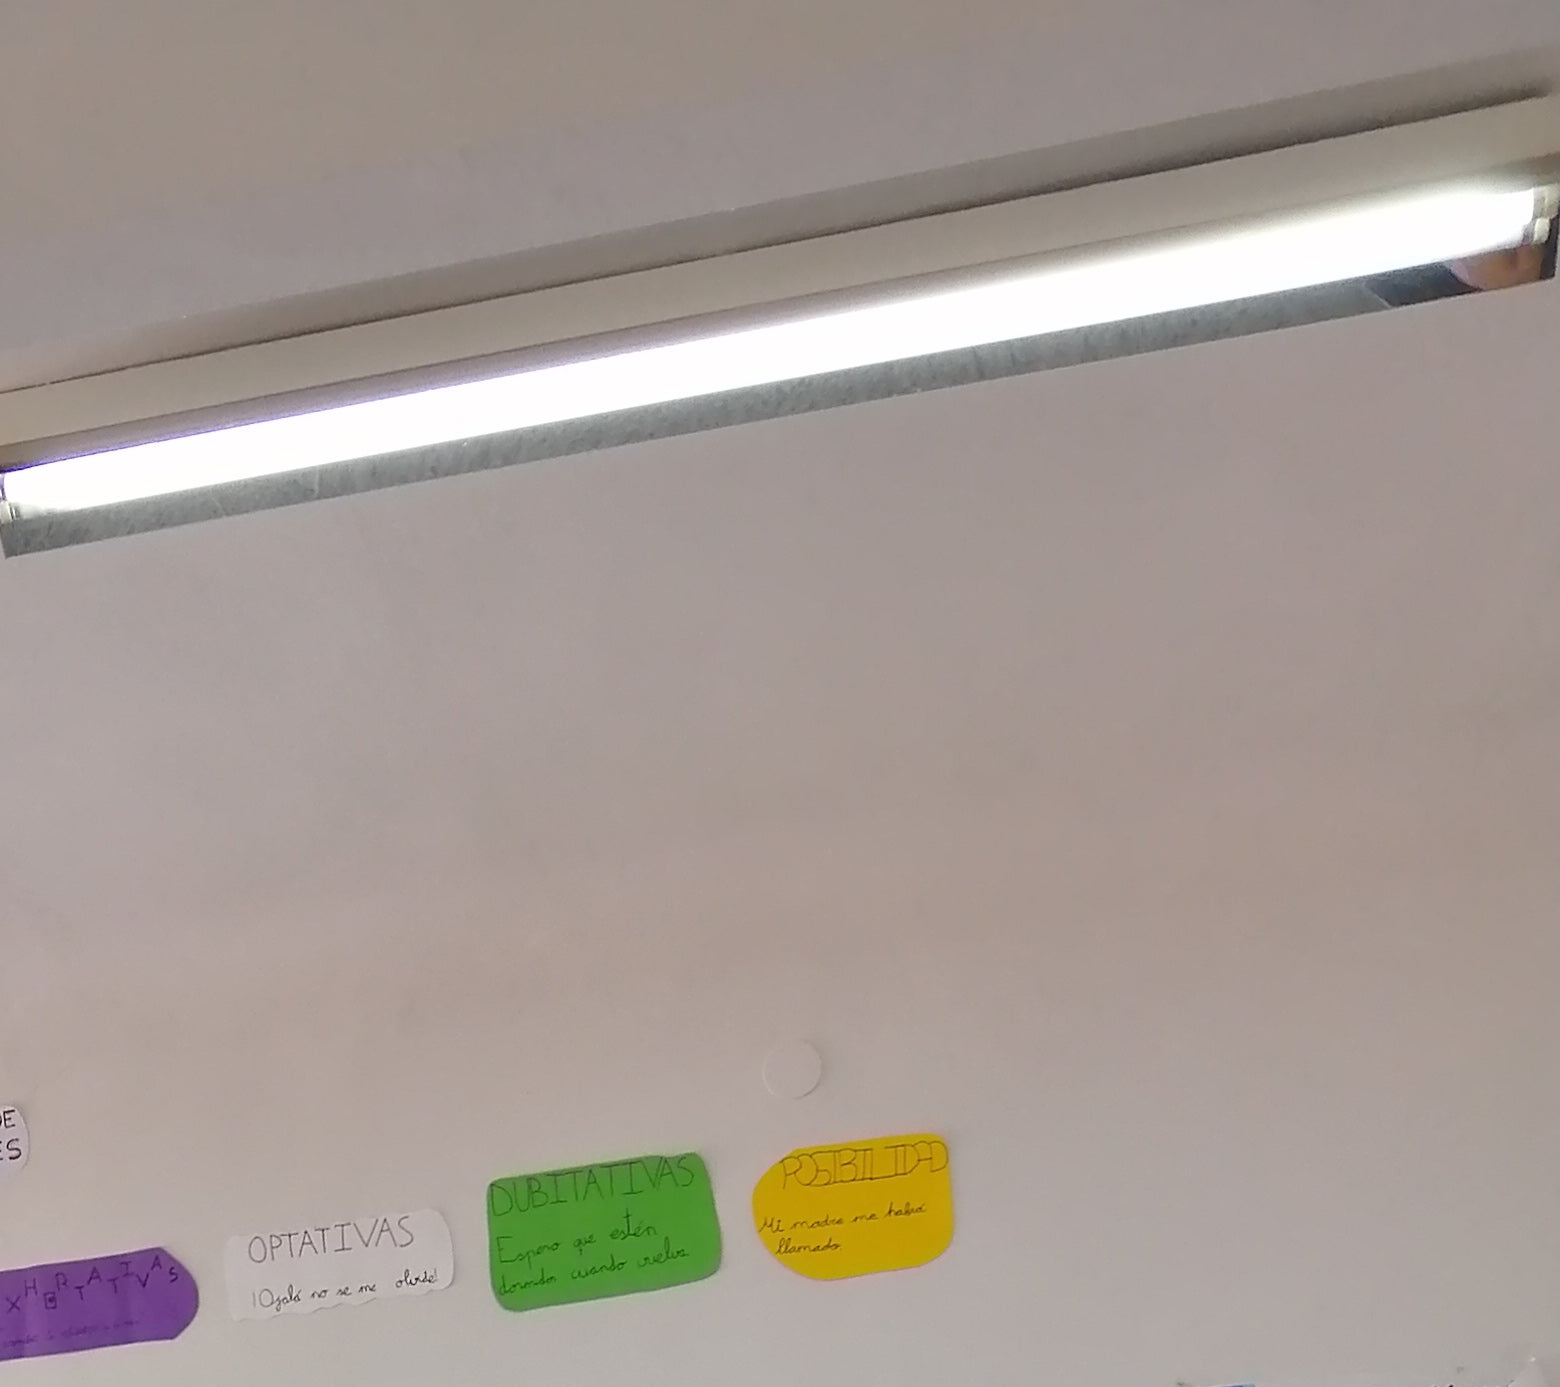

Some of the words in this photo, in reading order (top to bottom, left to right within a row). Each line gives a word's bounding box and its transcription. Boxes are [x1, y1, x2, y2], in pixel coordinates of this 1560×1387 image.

[489, 1152, 695, 1216] DUBITATIVAS
[248, 1215, 414, 1263] OPTATIVAS
[572, 1233, 595, 1256] que
[310, 1288, 328, 1299] no
[358, 1282, 377, 1293] me
